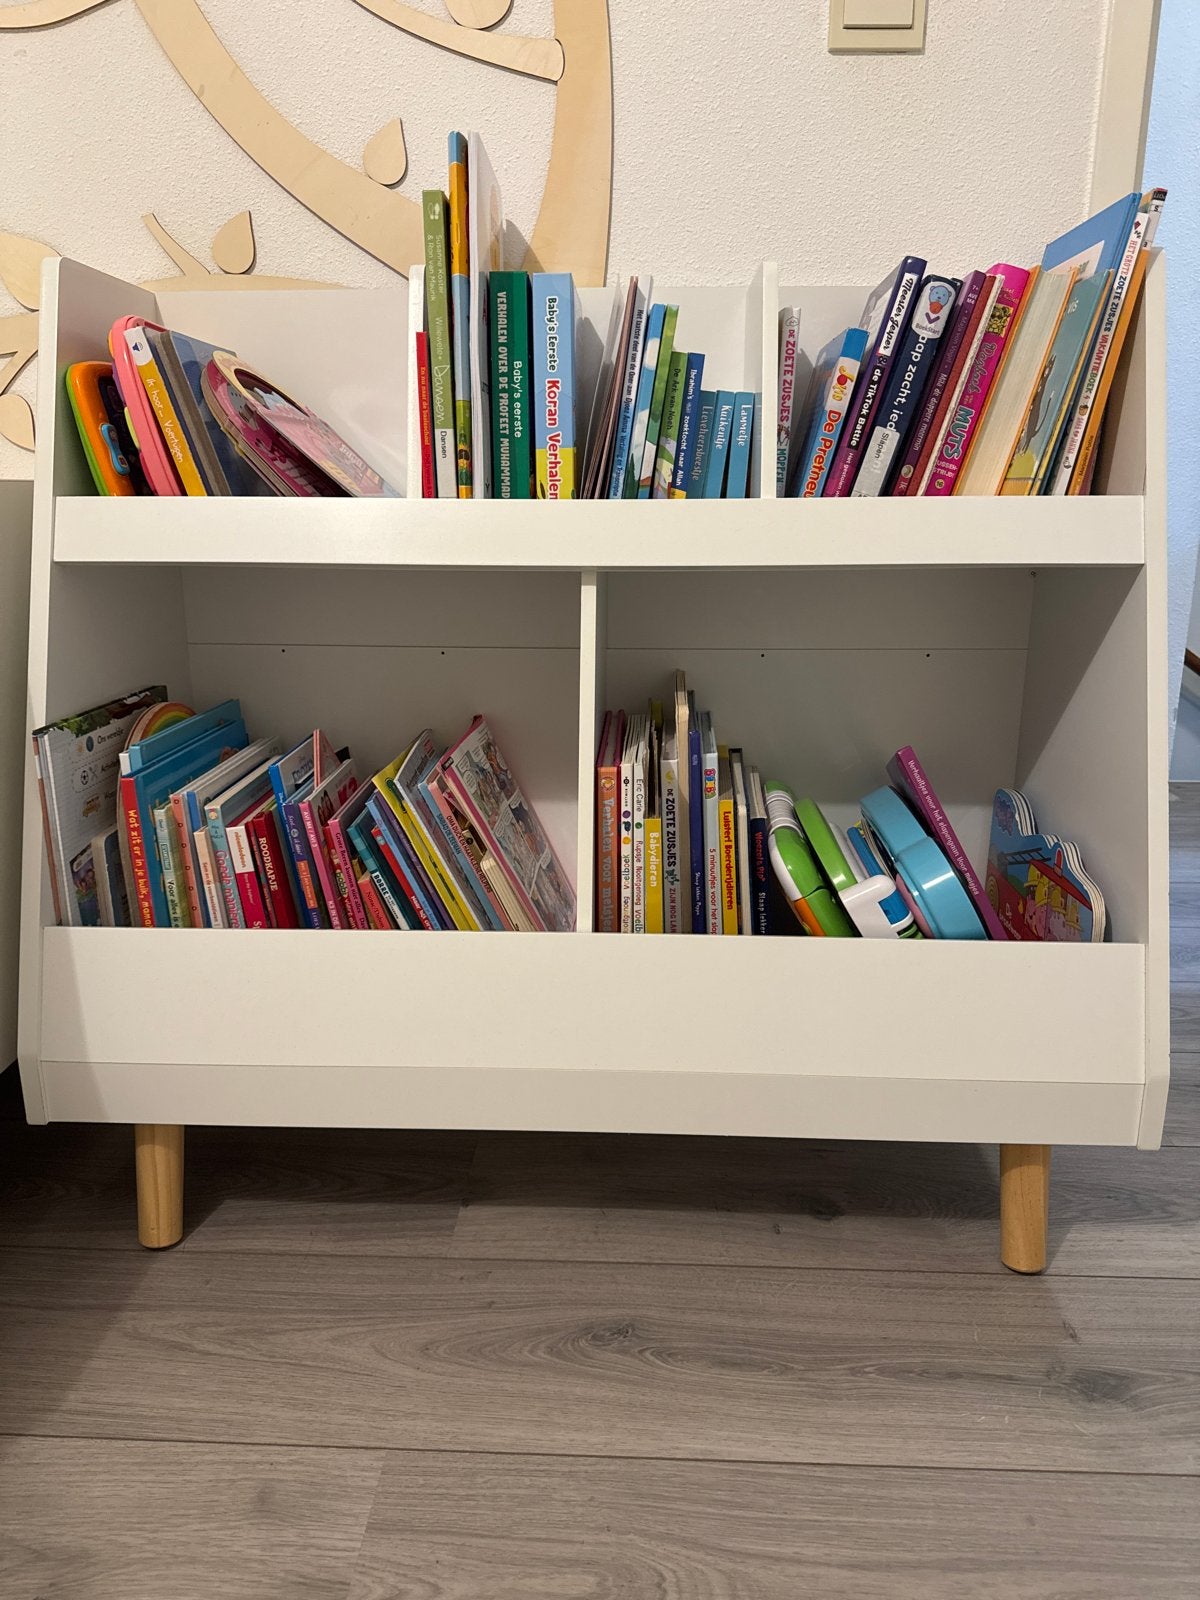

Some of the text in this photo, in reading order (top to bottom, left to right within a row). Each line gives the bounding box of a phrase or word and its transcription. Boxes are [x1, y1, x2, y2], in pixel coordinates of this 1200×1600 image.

[435, 234, 443, 266] Susanne
[1126, 239, 1136, 255] HET
[1120, 254, 1132, 275] GROTE
[1112, 275, 1126, 300] ZOETE
[883, 277, 913, 351] Meester Jesper
[1103, 301, 1118, 332] ZUSJES
[633, 320, 642, 339] laatste
[673, 368, 680, 377] De
[780, 329, 795, 422] DE ZOETE ZUSJES
[872, 368, 881, 381] de
[1085, 334, 1109, 393] VAKANTIEBOEK
[421, 376, 425, 384] nu
[434, 365, 449, 424] Dansen
[687, 369, 697, 399] Ibrahim's
[886, 333, 927, 431] aap zacht, ied
[933, 388, 941, 397] de
[936, 373, 947, 386] Mila
[422, 401, 427, 409] de
[497, 292, 510, 498] VERHALEN OVER DE PROFEET MUHAMMAD
[511, 360, 522, 437] Baby's eerste
[546, 297, 561, 498] Baby's Eerste Koran Verhalen
[860, 384, 877, 415] TikTok
[922, 397, 938, 422] dappere
[146, 378, 156, 387] Ik
[164, 420, 183, 463] Voertuigen
[680, 415, 689, 449] zoektocht
[714, 405, 732, 449] Kuikentje
[736, 404, 751, 446] Lammetje
[823, 408, 841, 432] De
[850, 417, 865, 446] Battle
[941, 404, 975, 460] MUTS
[691, 405, 712, 480] Lieveheersbeestje
[874, 432, 889, 458] Slapen
[912, 423, 927, 450] meermin
[776, 448, 786, 482] MOPPEN
[837, 464, 849, 489] gestolen
[128, 809, 138, 828] Wat
[665, 797, 675, 827] ZOETE
[907, 759, 928, 794] Verhaaltjes
[925, 795, 935, 808] voor
[933, 809, 942, 821] het
[938, 821, 959, 857] slapengaan
[963, 872, 979, 895] meisjes
[130, 830, 141, 843] zit
[133, 846, 141, 855] er
[634, 840, 643, 862] Rupsje
[666, 830, 676, 866] ZUSJES
[258, 837, 278, 890] ROODKAPJE
[335, 832, 343, 848] Grote
[340, 849, 348, 866] Beren
[344, 866, 354, 887] kunnen
[354, 899, 363, 913] alles
[601, 797, 614, 932] Verhalen voor meisjes
[621, 855, 631, 889] voelboek
[648, 832, 659, 886] Babydieren
[708, 854, 716, 888] minuutjes
[723, 811, 733, 909] Luister! Boerderijdieren
[138, 878, 148, 898] buik,
[167, 879, 175, 896] Voor
[215, 849, 233, 884] Goede
[224, 887, 241, 928] maniere
[373, 874, 388, 895] BORRE
[170, 898, 178, 914] alles
[757, 892, 765, 911] Slaap
[635, 909, 643, 932] voelb
